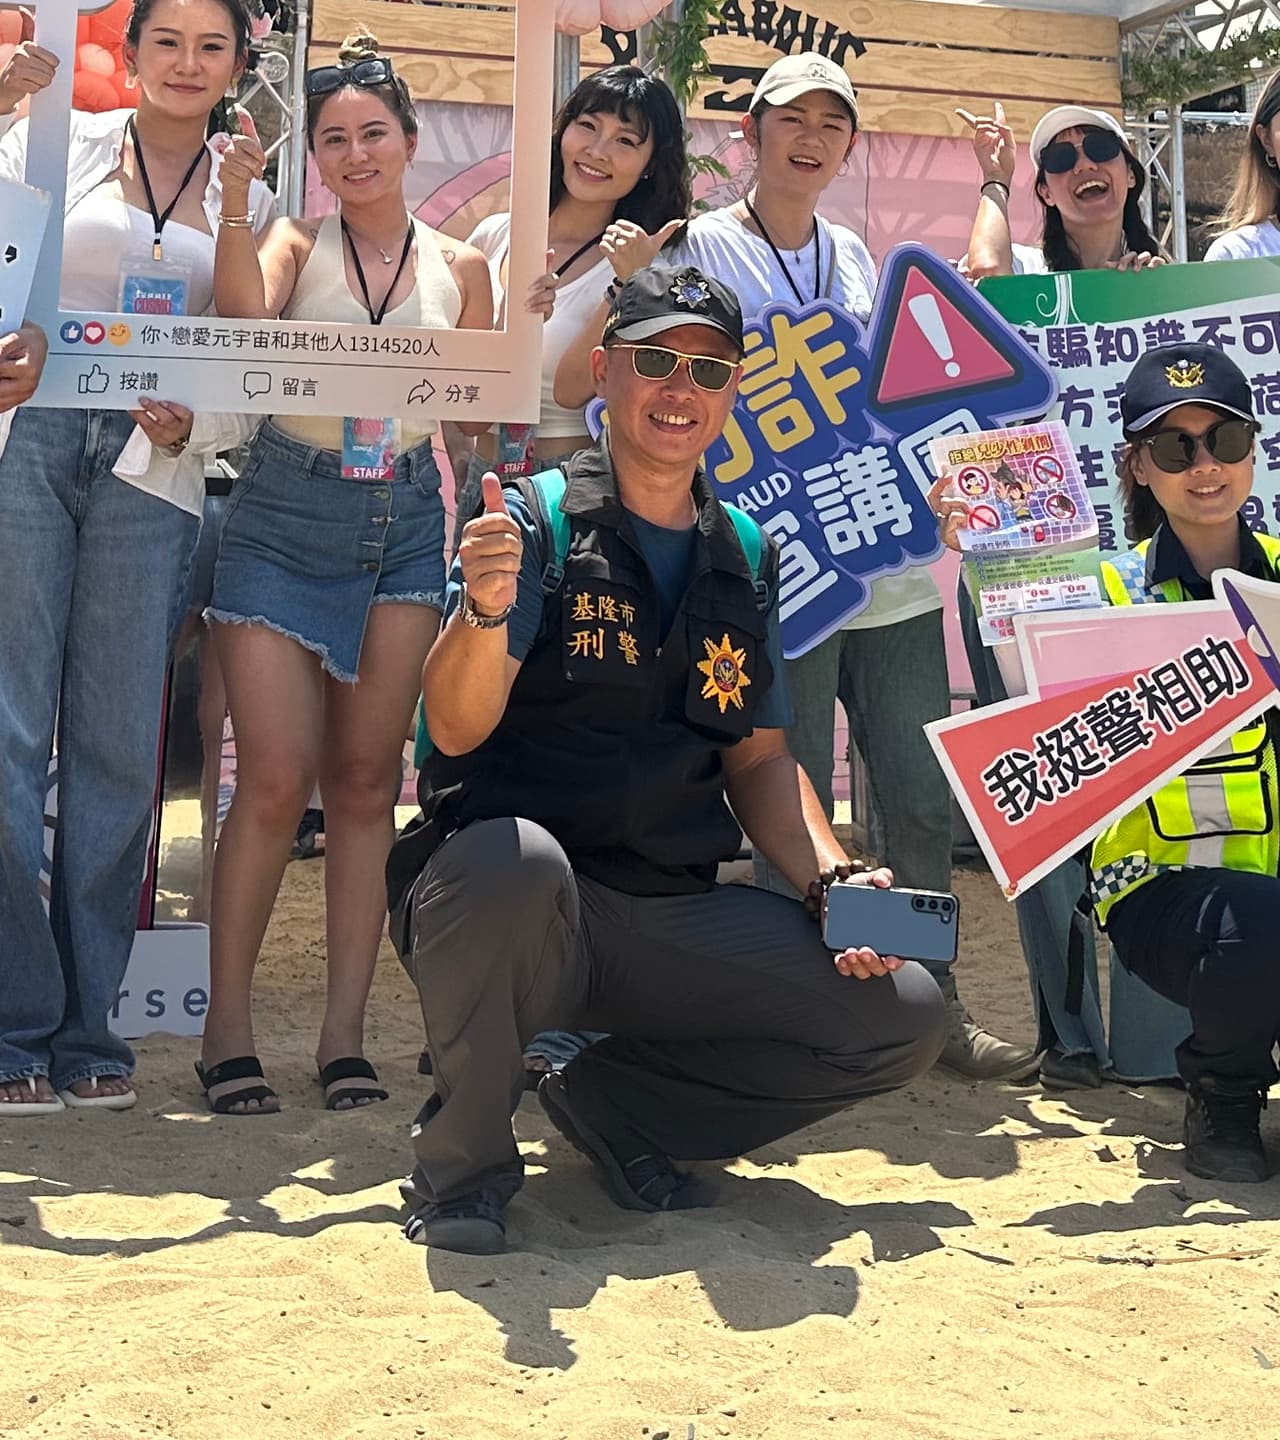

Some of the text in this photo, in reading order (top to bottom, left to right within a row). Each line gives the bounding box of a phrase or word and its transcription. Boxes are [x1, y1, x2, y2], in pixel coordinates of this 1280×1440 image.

[120, 371, 481, 404] 按讚 留言 分享
[353, 467, 385, 479] STAFF
[503, 461, 526, 474] STAFF
[570, 592, 636, 628] 基隆市
[567, 628, 640, 666] 刑警
[983, 635, 1252, 824] 我挺聲相助
